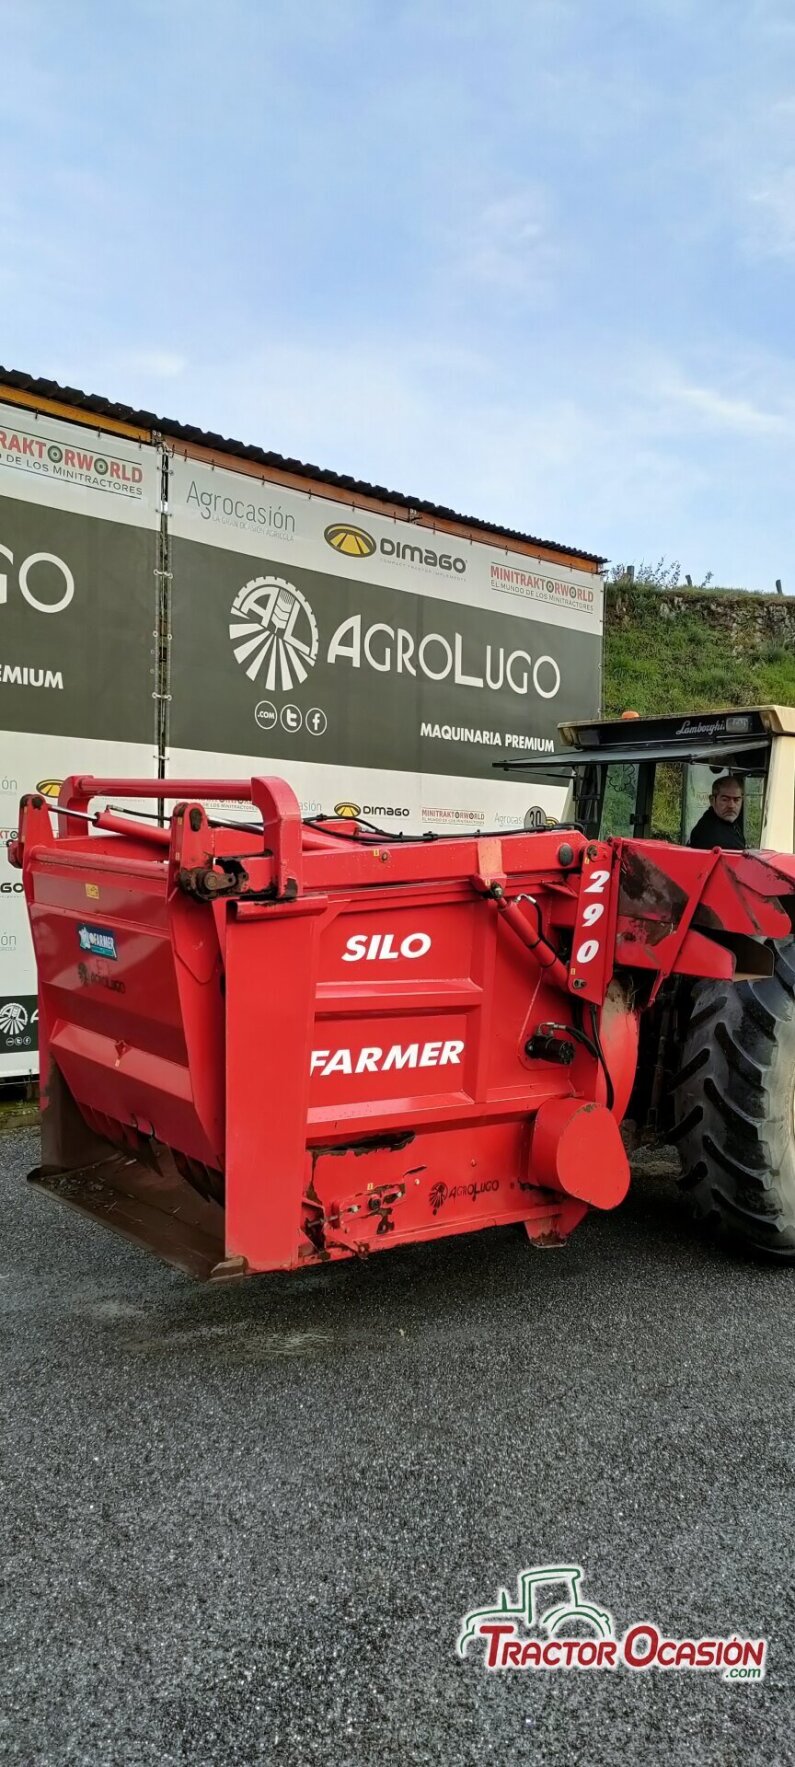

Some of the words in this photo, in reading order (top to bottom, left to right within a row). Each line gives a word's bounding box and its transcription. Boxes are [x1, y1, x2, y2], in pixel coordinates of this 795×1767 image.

[6, 454, 22, 466] DE
[26, 460, 49, 472] LOS
[53, 465, 143, 495] MINITRACTORES
[186, 480, 296, 532] Agrocasión
[490, 565, 594, 603] MINITRAKTORWORLD
[501, 583, 525, 594] MUNDO
[526, 589, 535, 598] DE
[536, 592, 548, 601] LOS
[420, 723, 502, 746] MAQUINARIA
[504, 733, 555, 753] PREMIUM
[341, 932, 432, 962] SILO
[310, 1040, 465, 1077] FARMER
